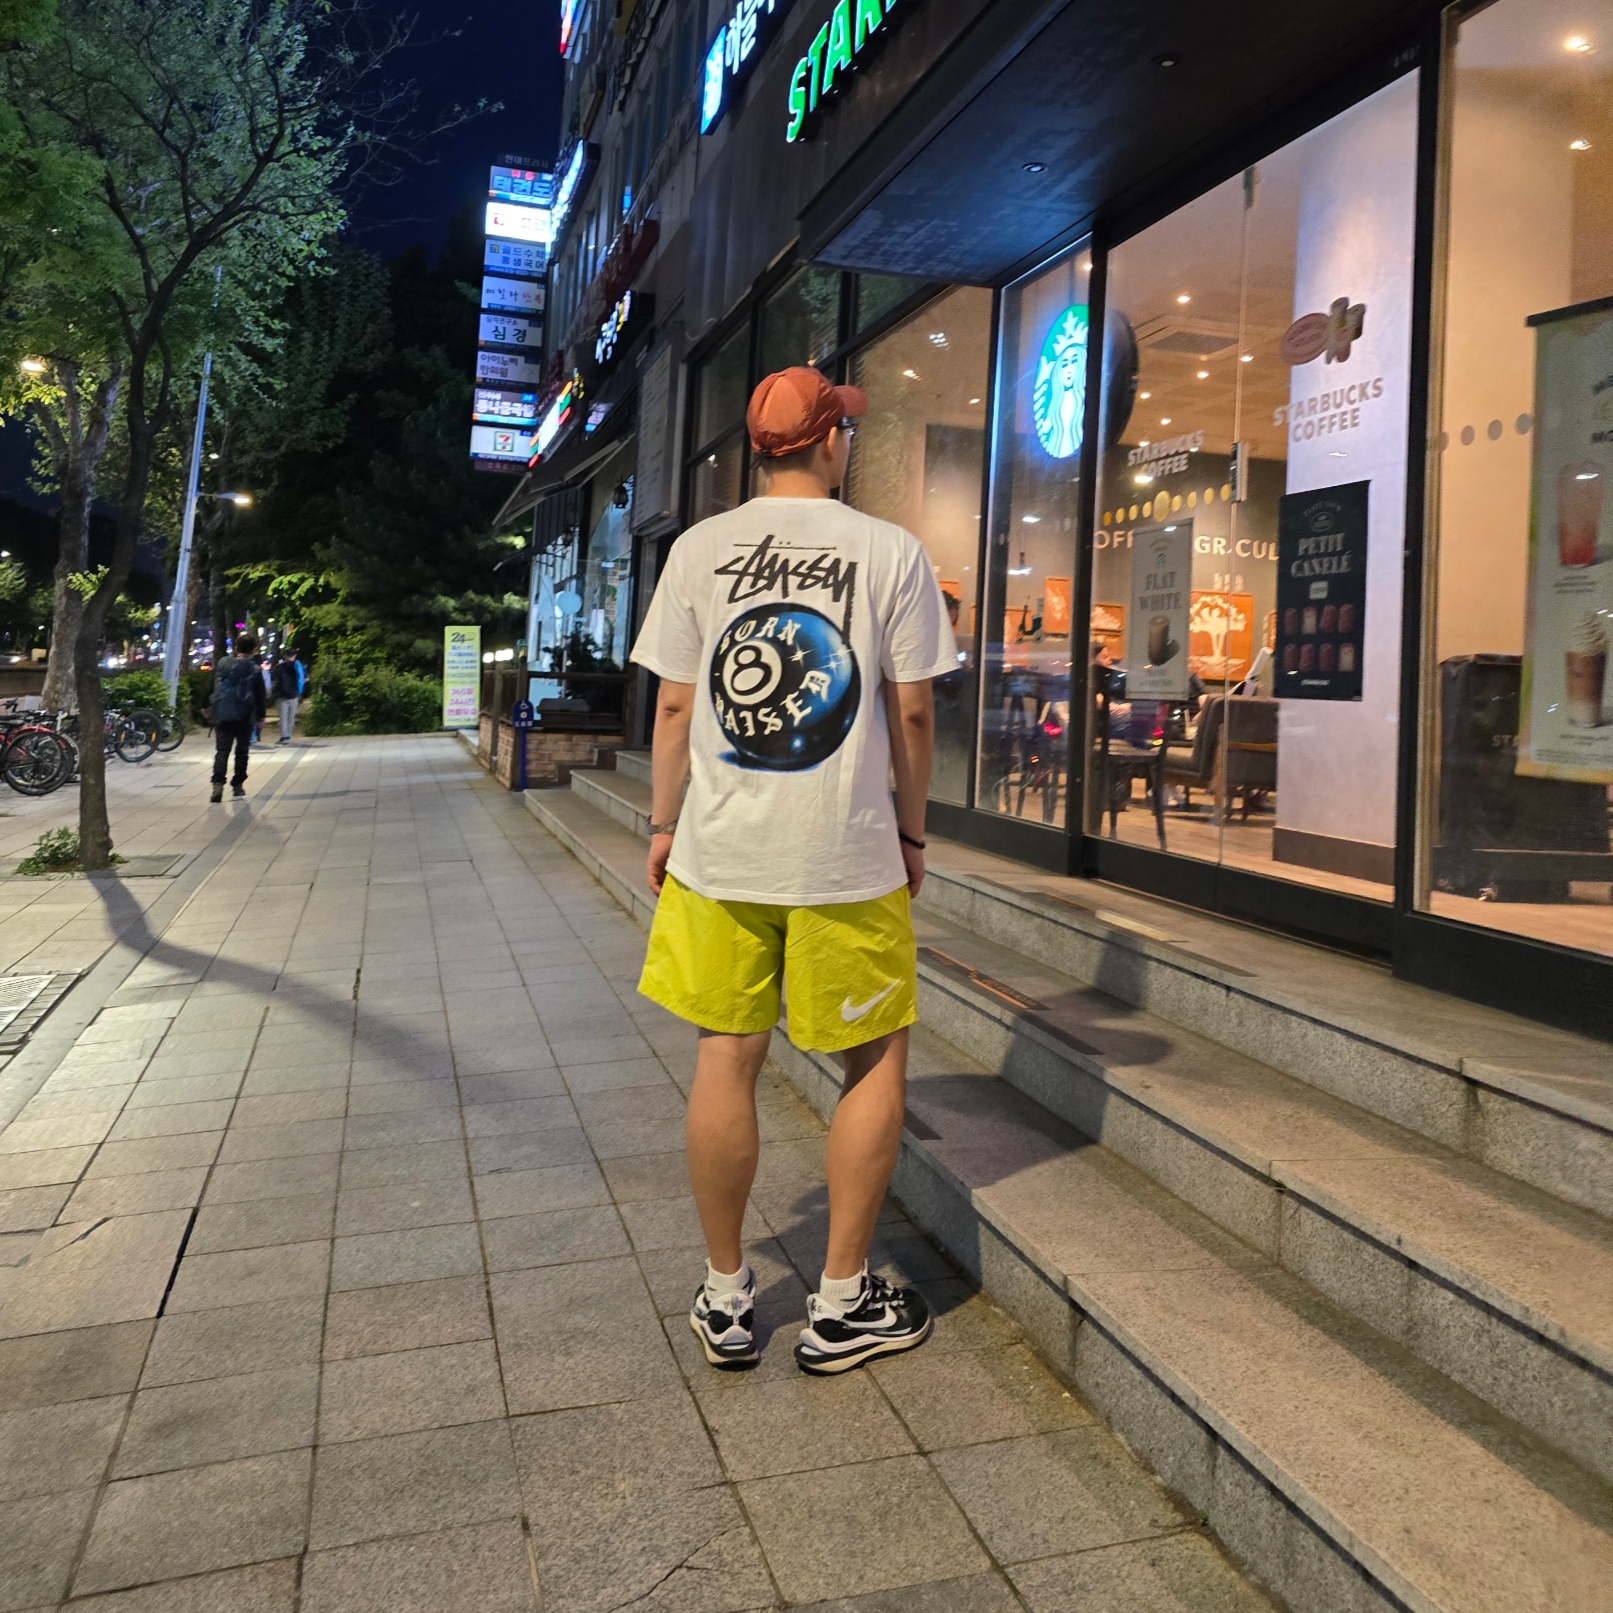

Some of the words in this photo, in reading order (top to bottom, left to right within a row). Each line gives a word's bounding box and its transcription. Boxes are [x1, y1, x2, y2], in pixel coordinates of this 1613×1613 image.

[786, 0, 897, 143] STAR
[493, 175, 551, 198] 태권도
[480, 364, 508, 378] 한의원
[1273, 377, 1384, 427] STARBUCKS
[1292, 406, 1361, 443] COFFEE
[1127, 430, 1206, 467] STARBUCKS
[1139, 453, 1190, 478] COFFEE
[1298, 532, 1346, 556] PETIT
[1290, 551, 1353, 578] CANELÉ
[1145, 571, 1177, 591] FLAT
[1139, 592, 1183, 611] WHITE
[718, 615, 802, 656] BORN
[730, 644, 774, 697] 8
[714, 669, 832, 737] RAISED
